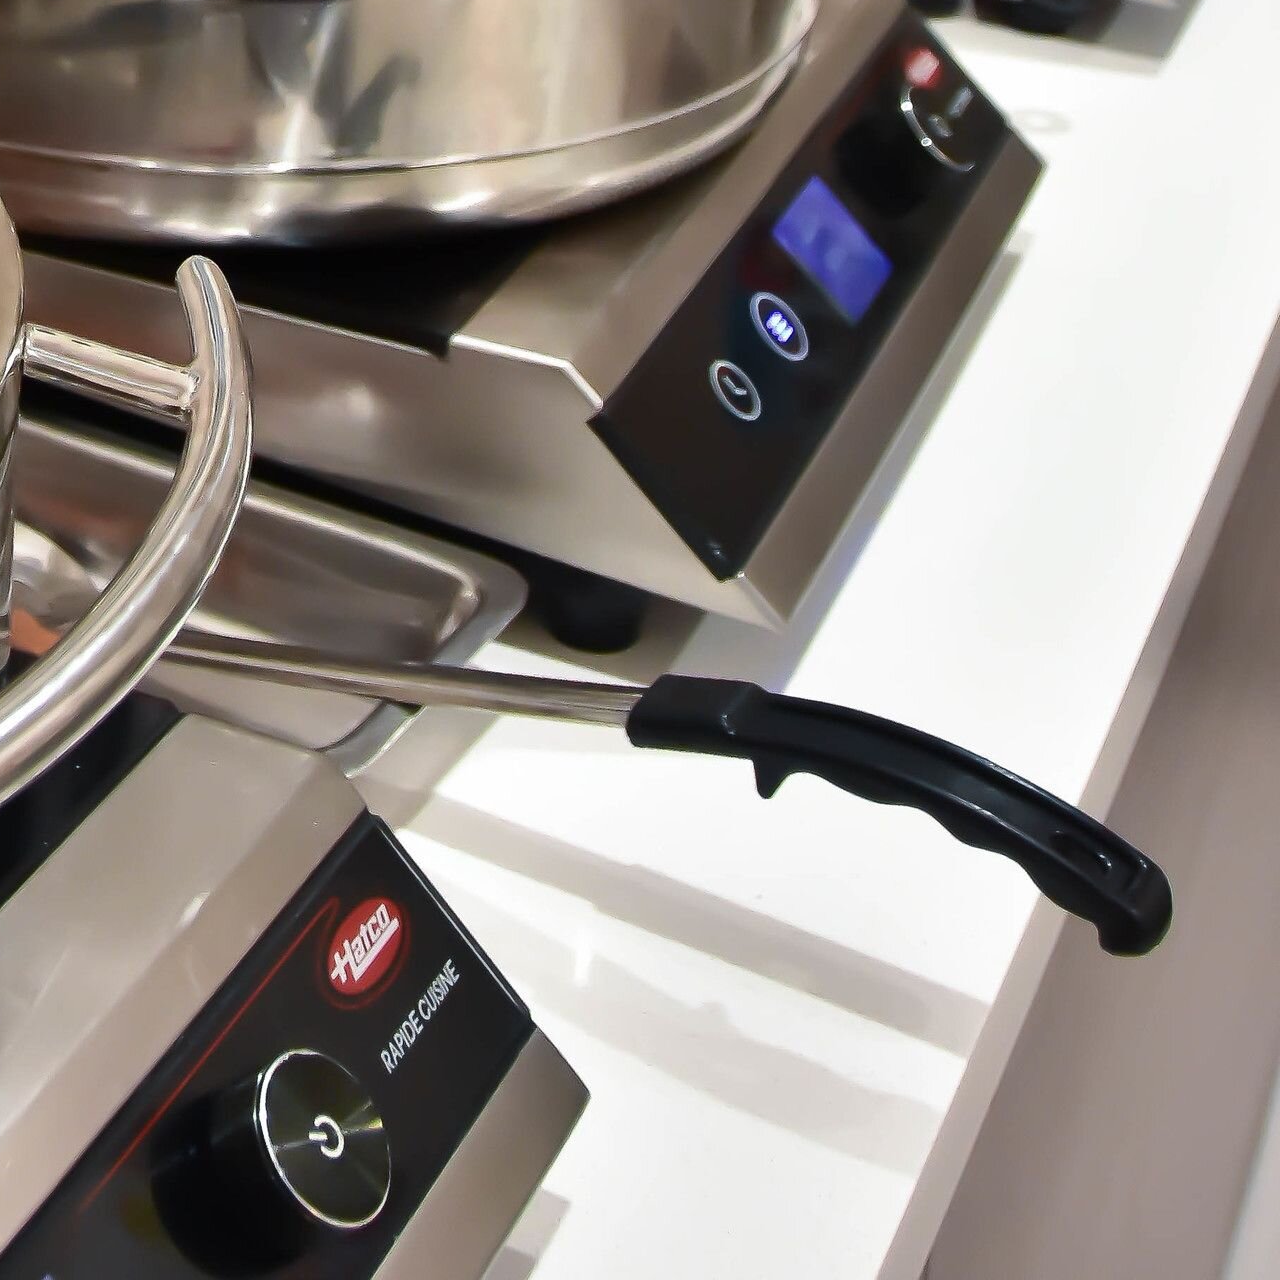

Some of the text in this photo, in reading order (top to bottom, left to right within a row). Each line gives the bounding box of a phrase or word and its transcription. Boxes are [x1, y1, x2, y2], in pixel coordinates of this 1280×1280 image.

[330, 903, 400, 984] Hatco
[380, 958, 460, 1074] RAPIDE CUISINE
